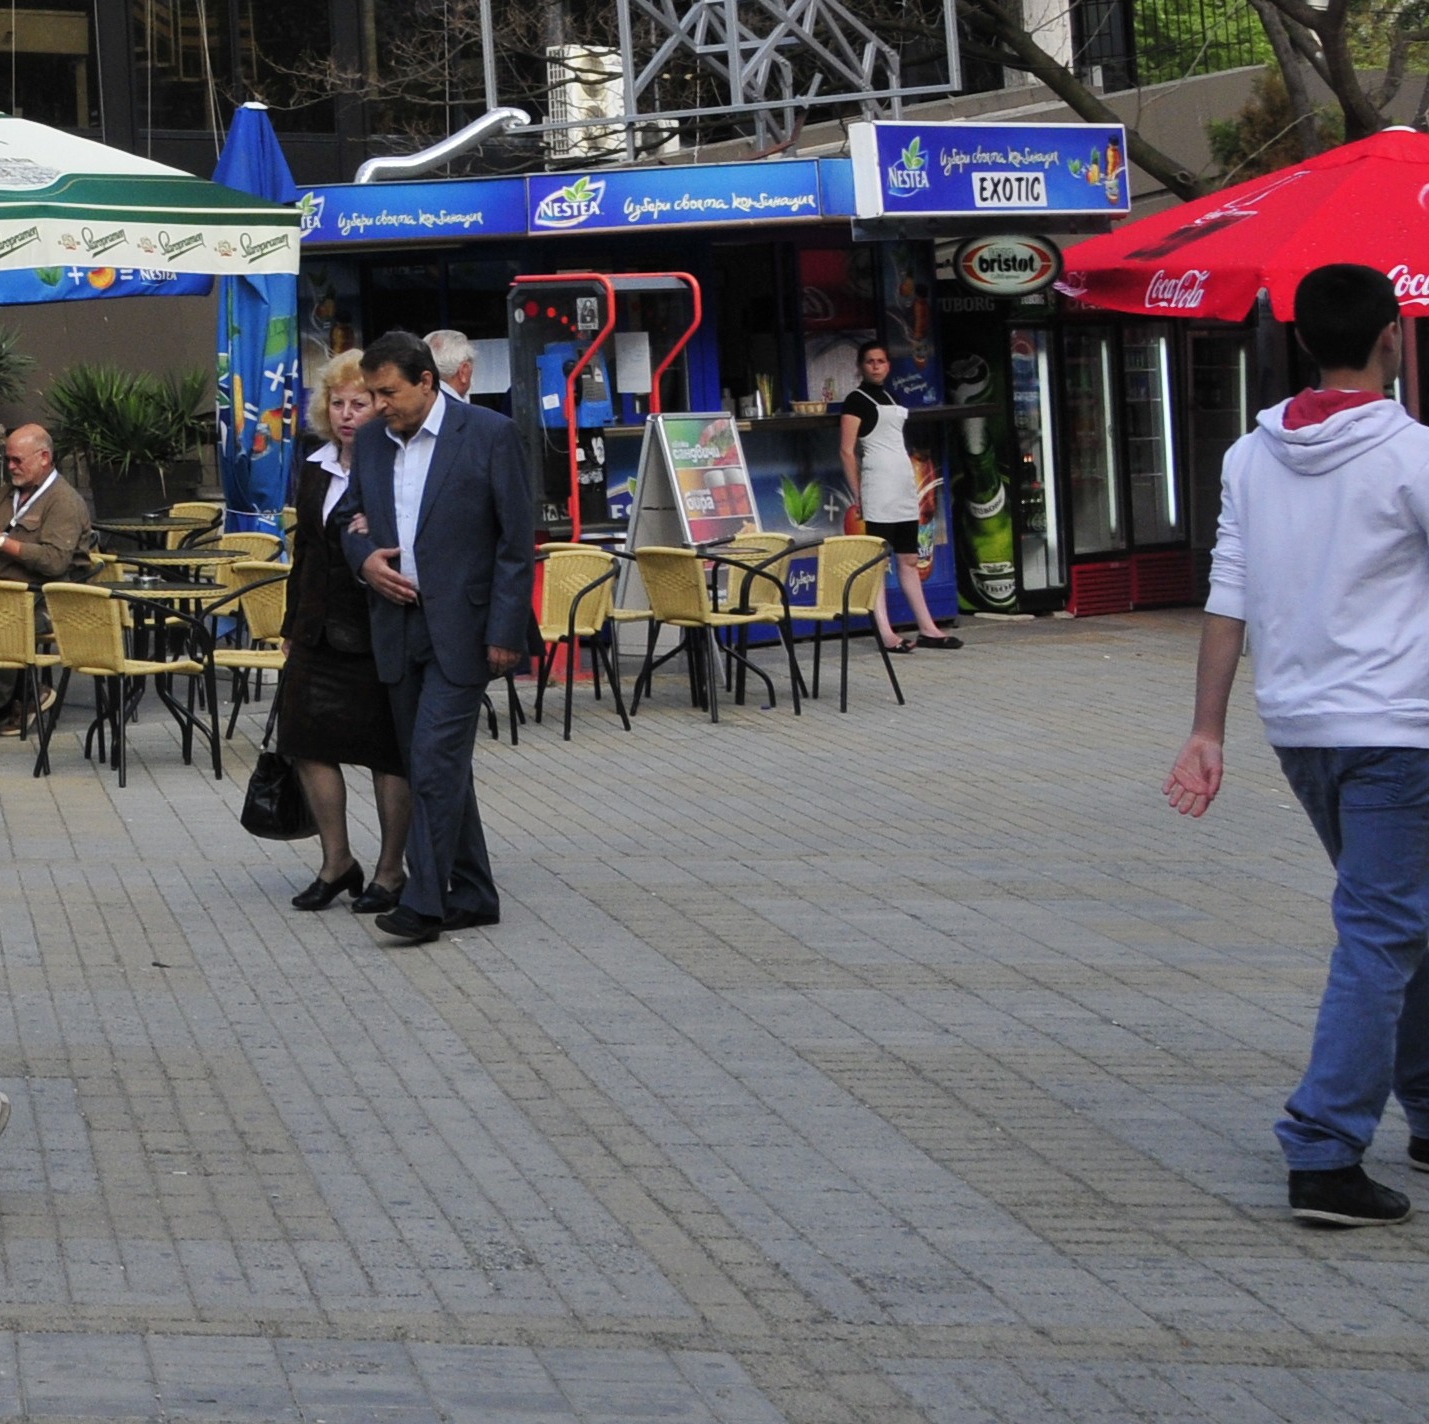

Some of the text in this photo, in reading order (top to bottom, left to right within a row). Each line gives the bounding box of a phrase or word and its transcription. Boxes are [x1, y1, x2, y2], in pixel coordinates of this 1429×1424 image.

[888, 168, 930, 188] NESTEA
[979, 176, 1042, 203] EXOTIC
[540, 201, 601, 218] NESTEA
[624, 192, 815, 223] Избери своята комбинация
[338, 212, 373, 235] Избери
[375, 209, 417, 226] своята
[978, 253, 1038, 275] bristot
[938, 297, 996, 313] UBORG
